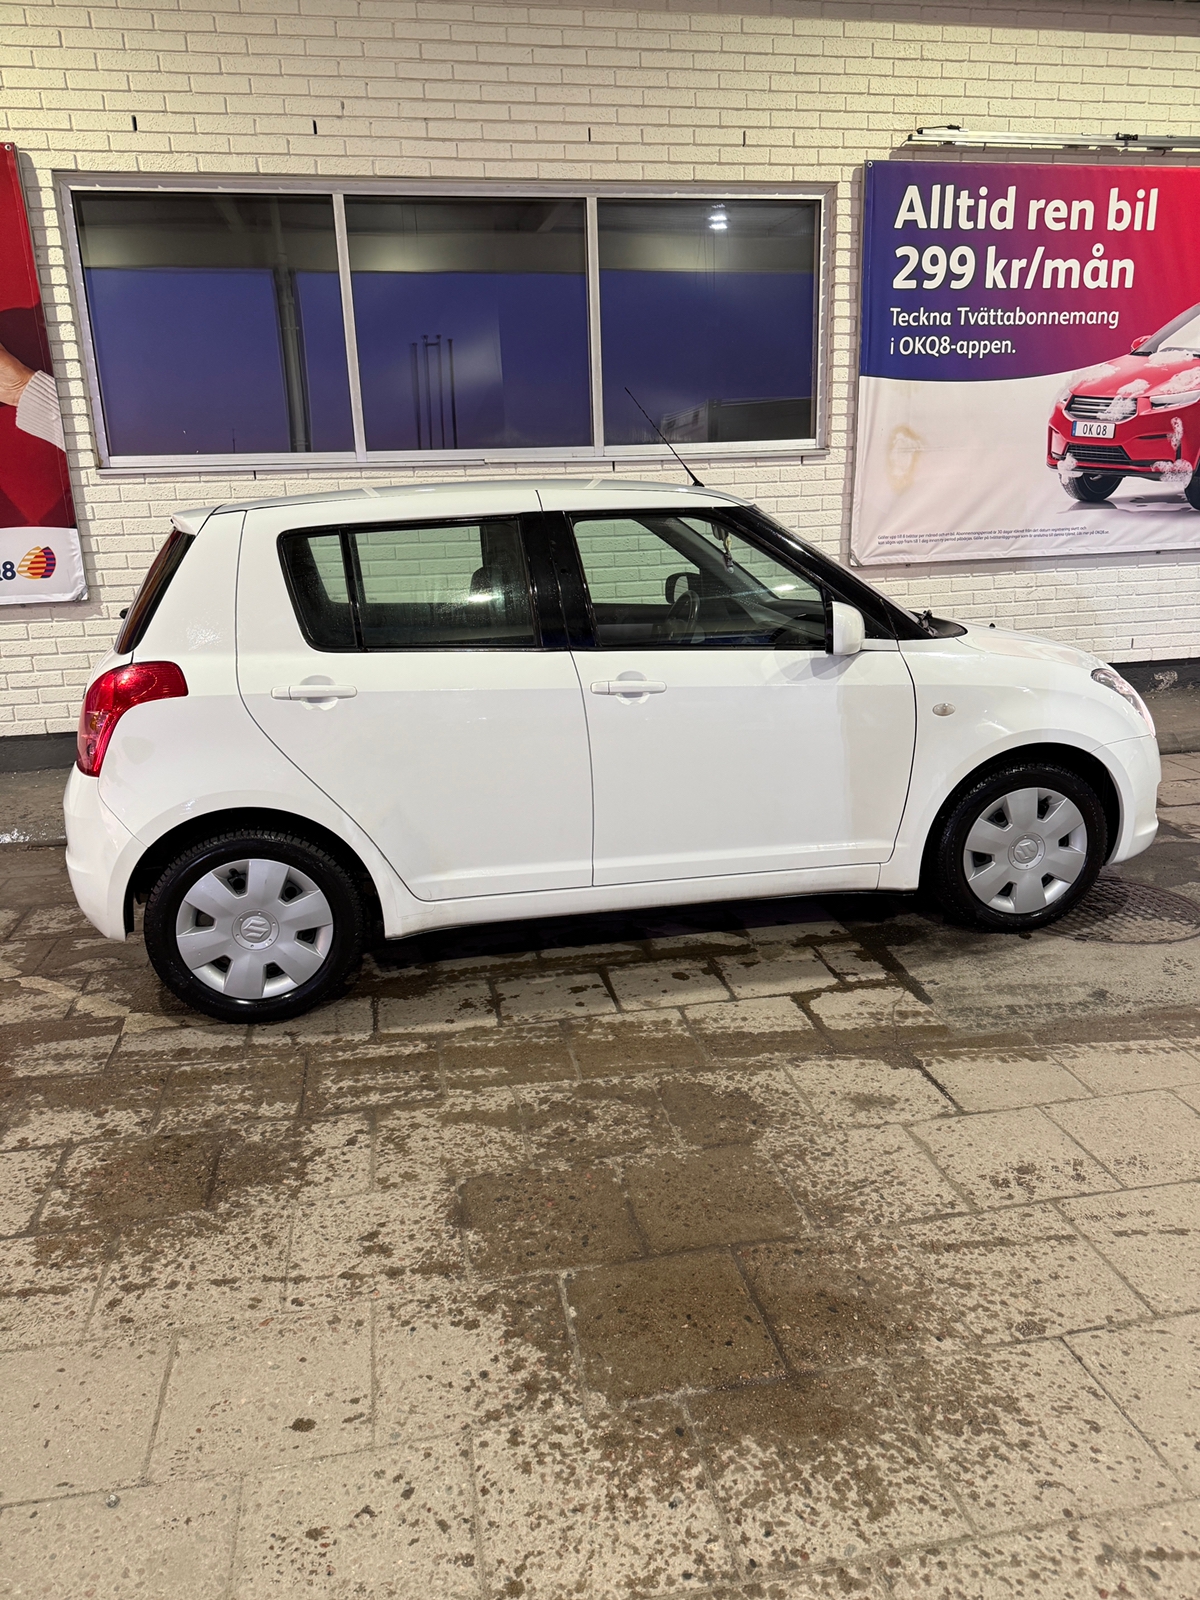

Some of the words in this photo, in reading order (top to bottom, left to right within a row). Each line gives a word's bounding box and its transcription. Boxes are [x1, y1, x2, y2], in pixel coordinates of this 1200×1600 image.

[894, 185, 1016, 230] Alltid
[1028, 199, 1094, 230] ren
[1107, 188, 1158, 231] bil
[893, 246, 975, 289] 299
[986, 243, 1134, 289] kr/mån
[890, 307, 951, 326] Teckna
[957, 307, 1119, 329] Tvättabonnemang
[891, 338, 894, 354] i
[900, 336, 1015, 358] OKQ8-appen.
[1083, 424, 1094, 435] OK
[1096, 425, 1107, 436] Q8
